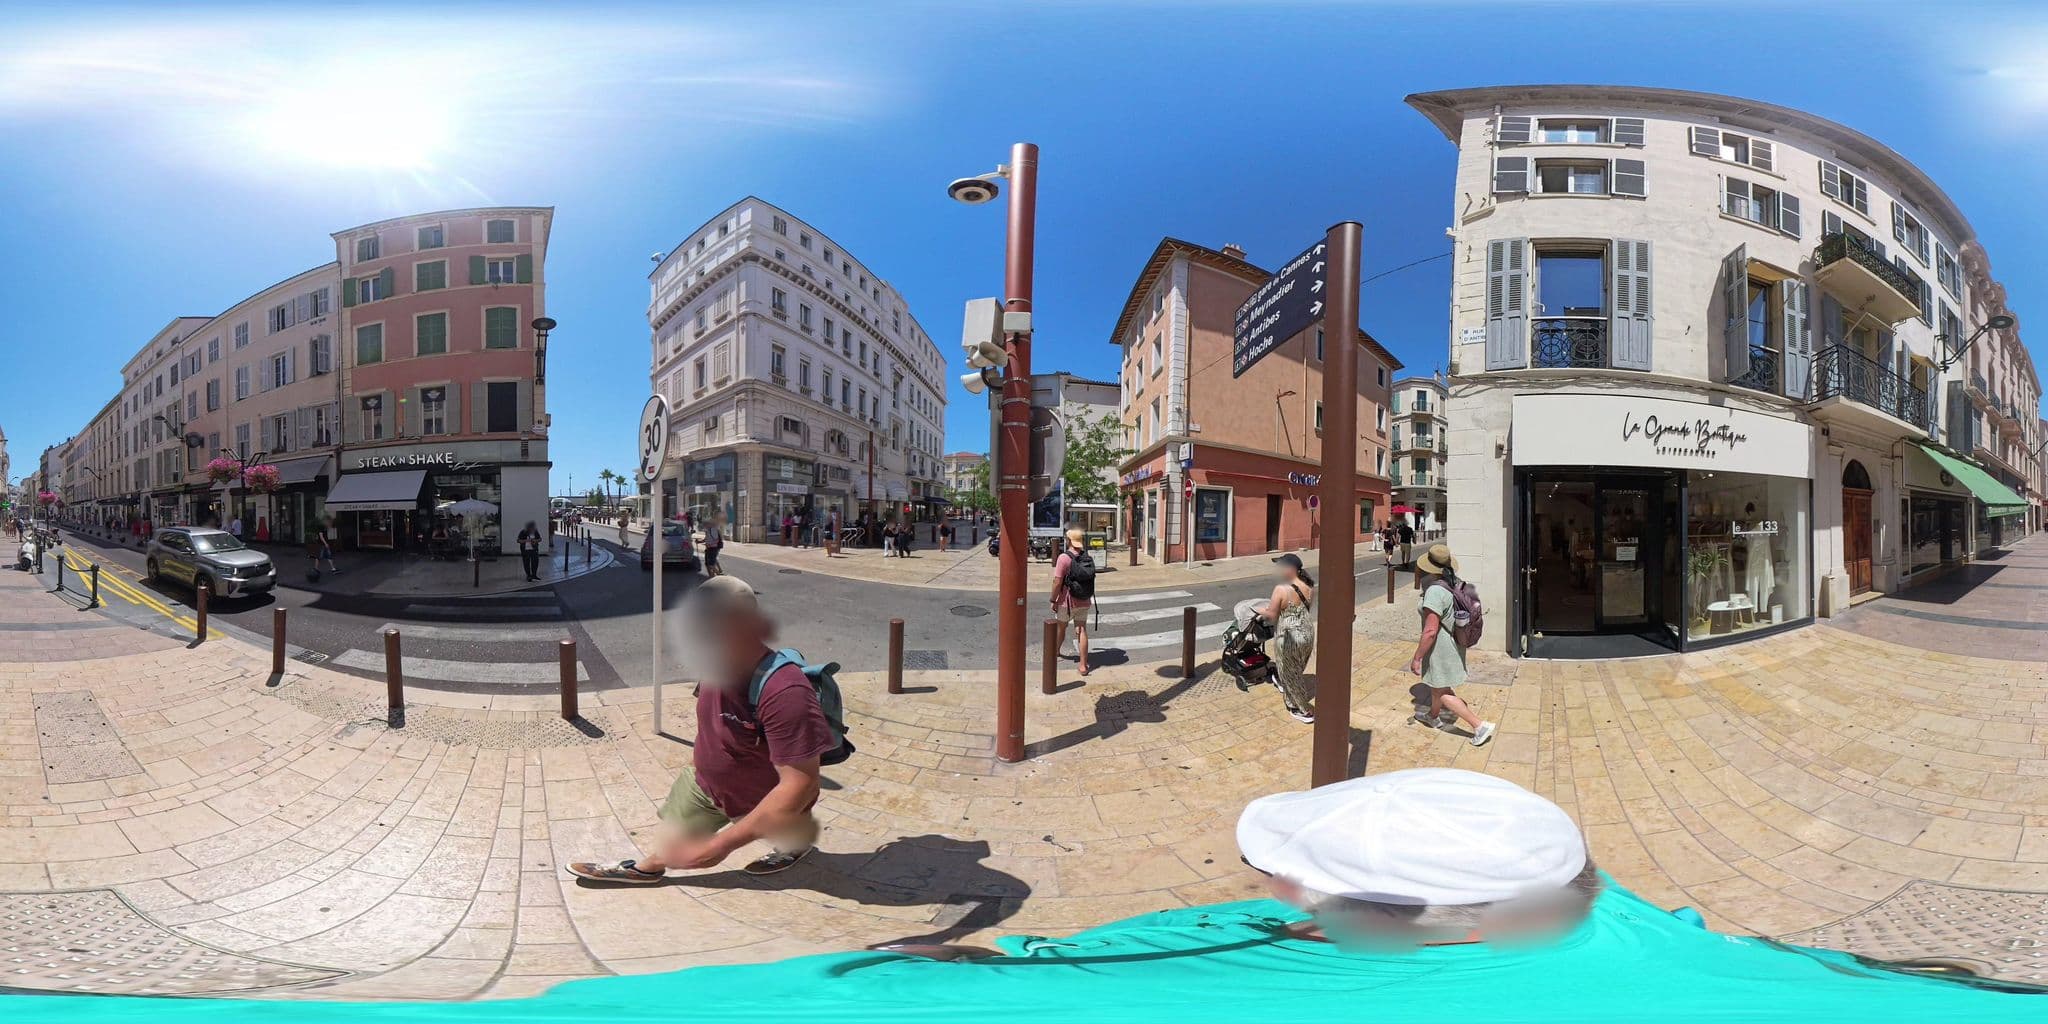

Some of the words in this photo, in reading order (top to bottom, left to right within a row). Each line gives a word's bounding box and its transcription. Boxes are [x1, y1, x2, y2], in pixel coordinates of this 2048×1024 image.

[1280, 252, 1311, 279] Cannes
[1249, 279, 1296, 324] Meynadier
[1248, 310, 1281, 342] Antibes
[1248, 335, 1274, 361] Hoche
[644, 418, 661, 457] 30
[1623, 412, 1641, 442] La
[1644, 414, 1691, 446] Grande
[1694, 418, 1747, 450] Boutique
[358, 455, 397, 469] STEAK
[408, 452, 454, 465] SHAKE
[1758, 520, 1778, 532] 133
